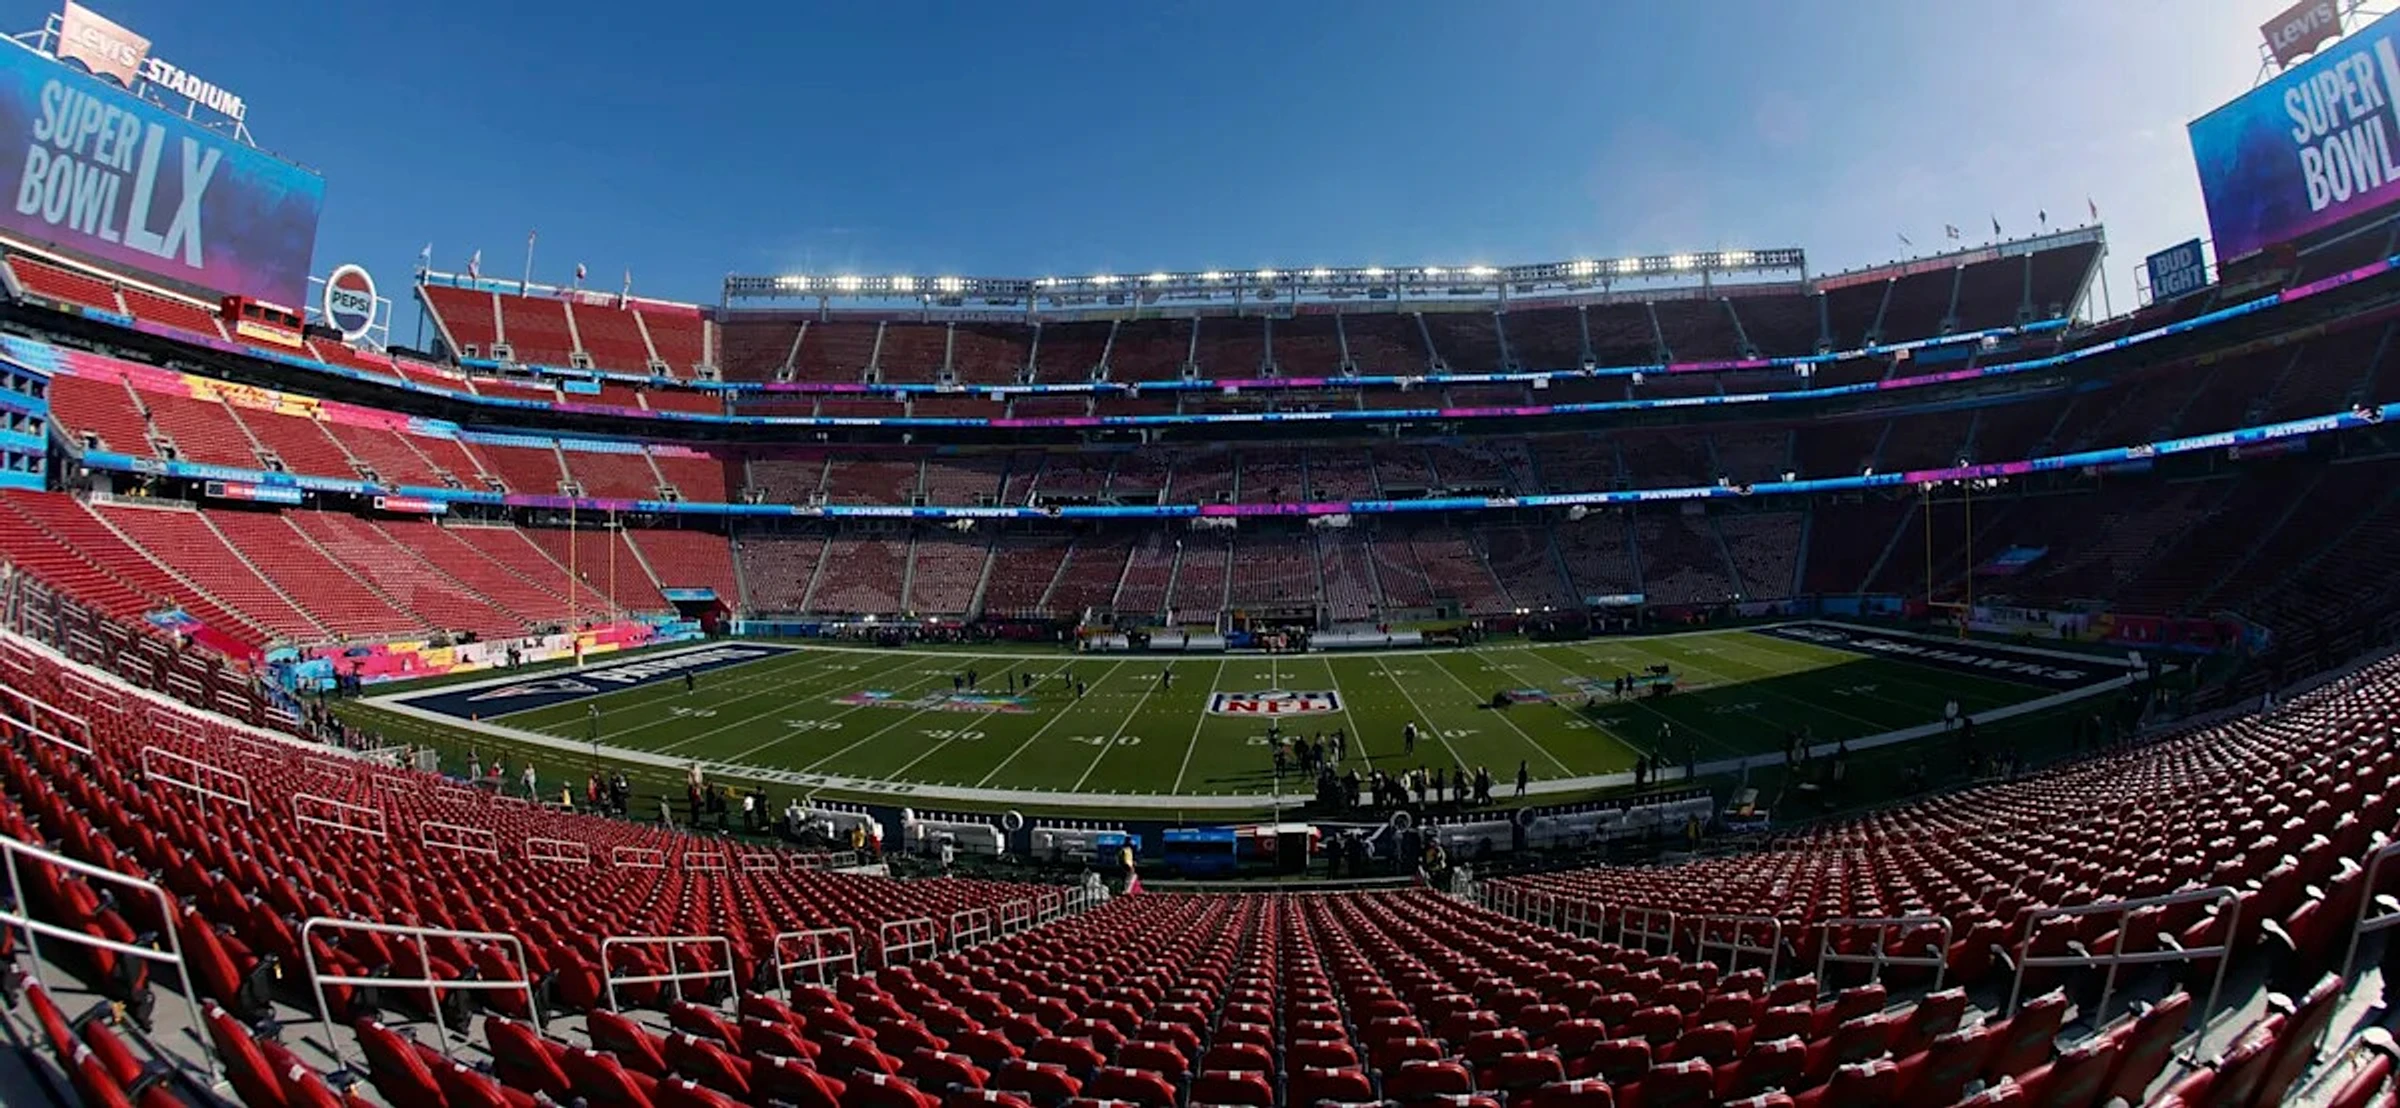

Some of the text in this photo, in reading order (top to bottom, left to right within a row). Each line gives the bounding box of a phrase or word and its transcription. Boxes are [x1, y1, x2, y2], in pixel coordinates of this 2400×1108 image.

[147, 58, 242, 118] STADIUM
[2284, 51, 2384, 144] SUPER
[34, 80, 141, 172] SUPER
[2299, 116, 2400, 212] BOWL
[16, 144, 120, 243] BOWL
[124, 122, 223, 269] LX
[2155, 248, 2193, 276] BUD
[2152, 264, 2201, 298] LIGHT
[332, 292, 369, 313] PEPSI
[2265, 417, 2339, 438] PATRIOTS
[1640, 487, 1711, 500] PATRIOTS
[946, 507, 1019, 517] PATRIOTS
[522, 637, 545, 649] LX
[1228, 699, 1326, 712] NFL
